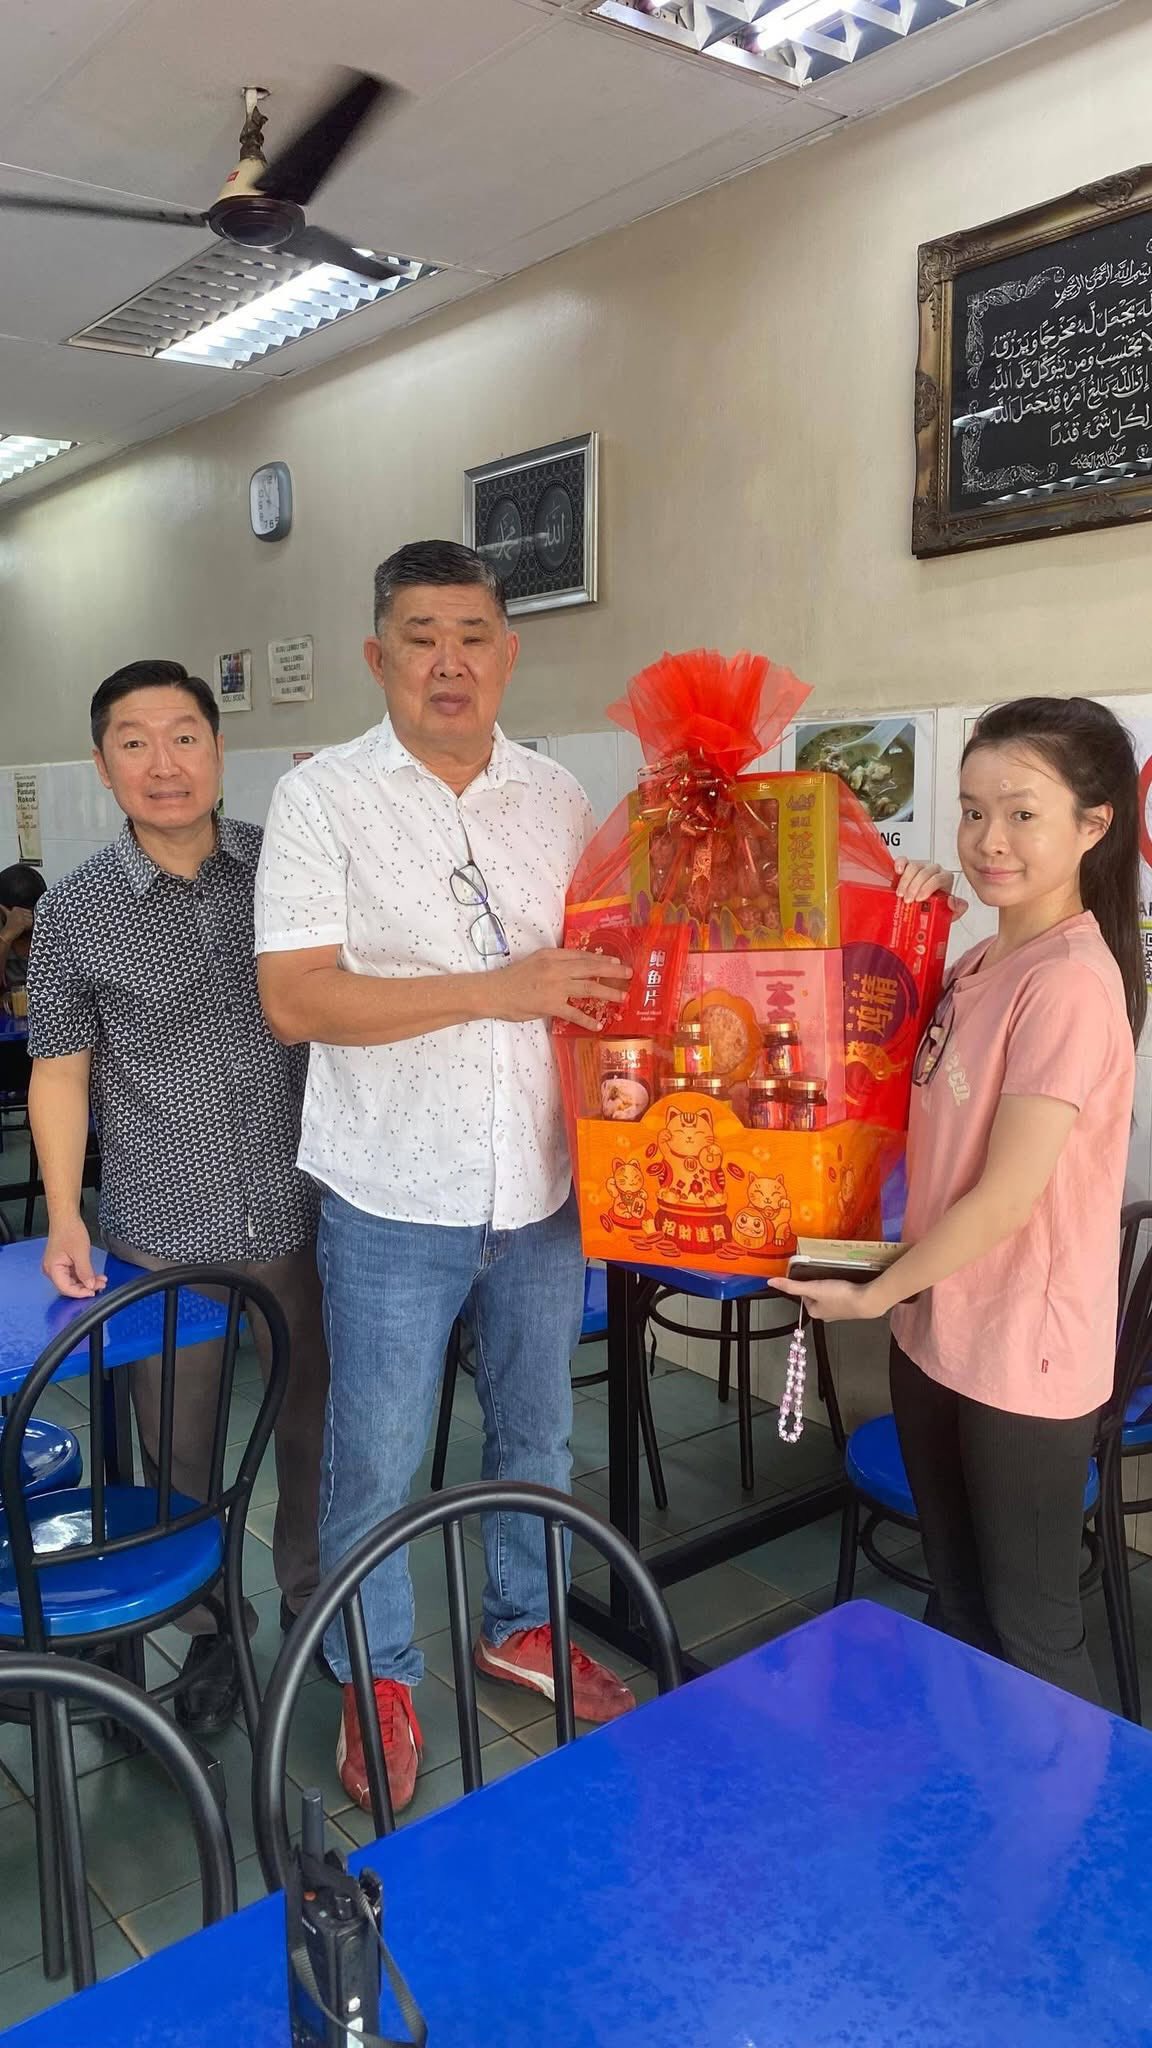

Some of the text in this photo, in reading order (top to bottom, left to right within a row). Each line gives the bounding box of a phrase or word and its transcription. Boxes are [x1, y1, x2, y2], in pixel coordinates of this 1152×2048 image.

[643, 950, 666, 1008] 鲍鱼片
[856, 973, 898, 1038] 鸡精
